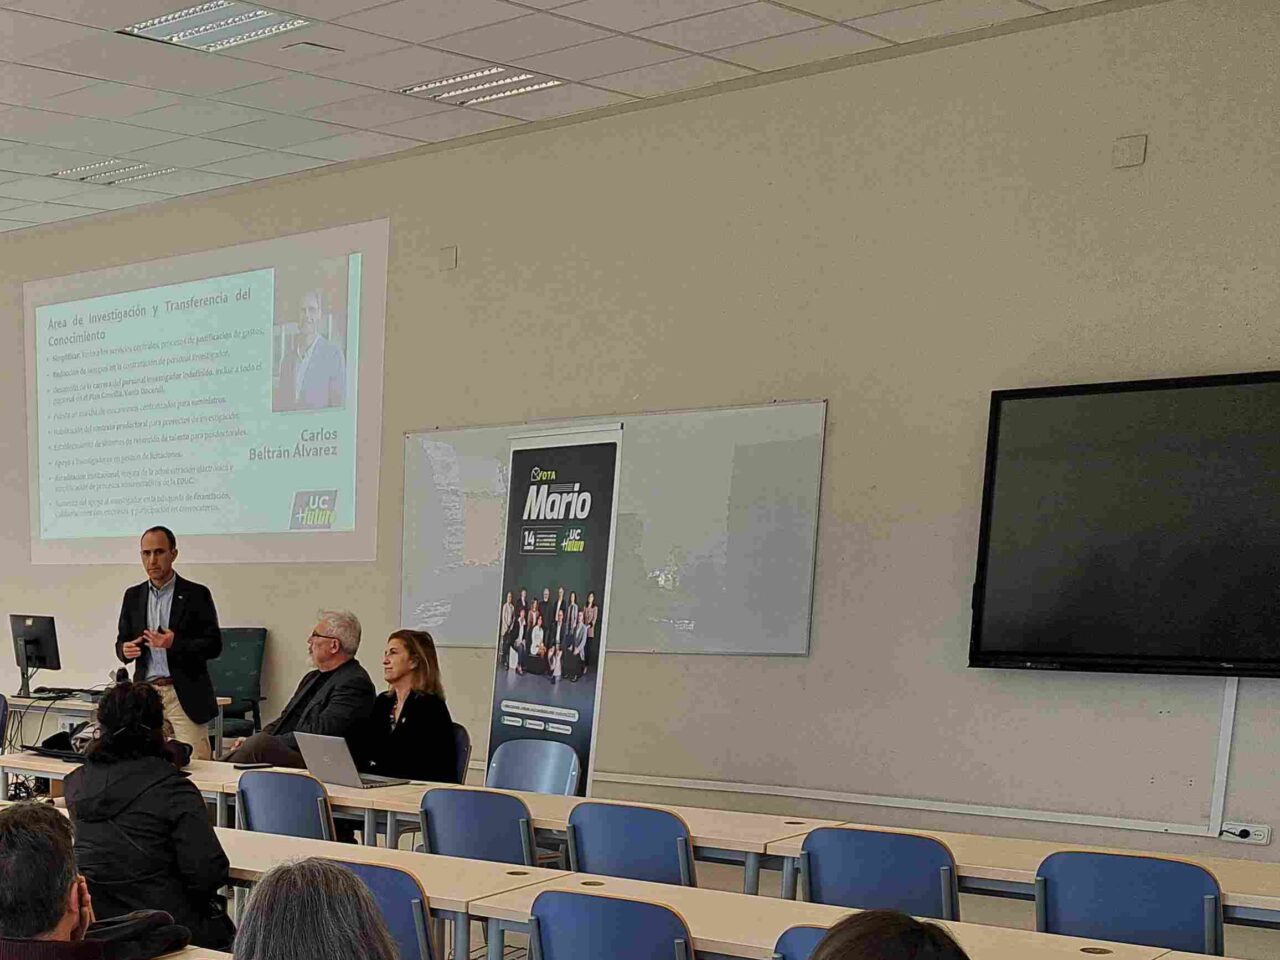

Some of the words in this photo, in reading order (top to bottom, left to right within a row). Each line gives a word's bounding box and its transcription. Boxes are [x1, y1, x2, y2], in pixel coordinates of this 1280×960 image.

[72, 313, 84, 327] de
[88, 304, 147, 324] Investigación
[152, 304, 159, 318] y
[165, 291, 229, 312] Transferencia
[235, 287, 251, 302] del
[48, 330, 106, 347] Conocimiento
[300, 427, 338, 442] Carlos
[249, 445, 290, 461] Beltrán
[293, 443, 338, 459] Álvarez
[308, 495, 329, 510] UC
[522, 482, 592, 520] Mario
[523, 530, 536, 546] 14
[569, 528, 582, 540] UC
